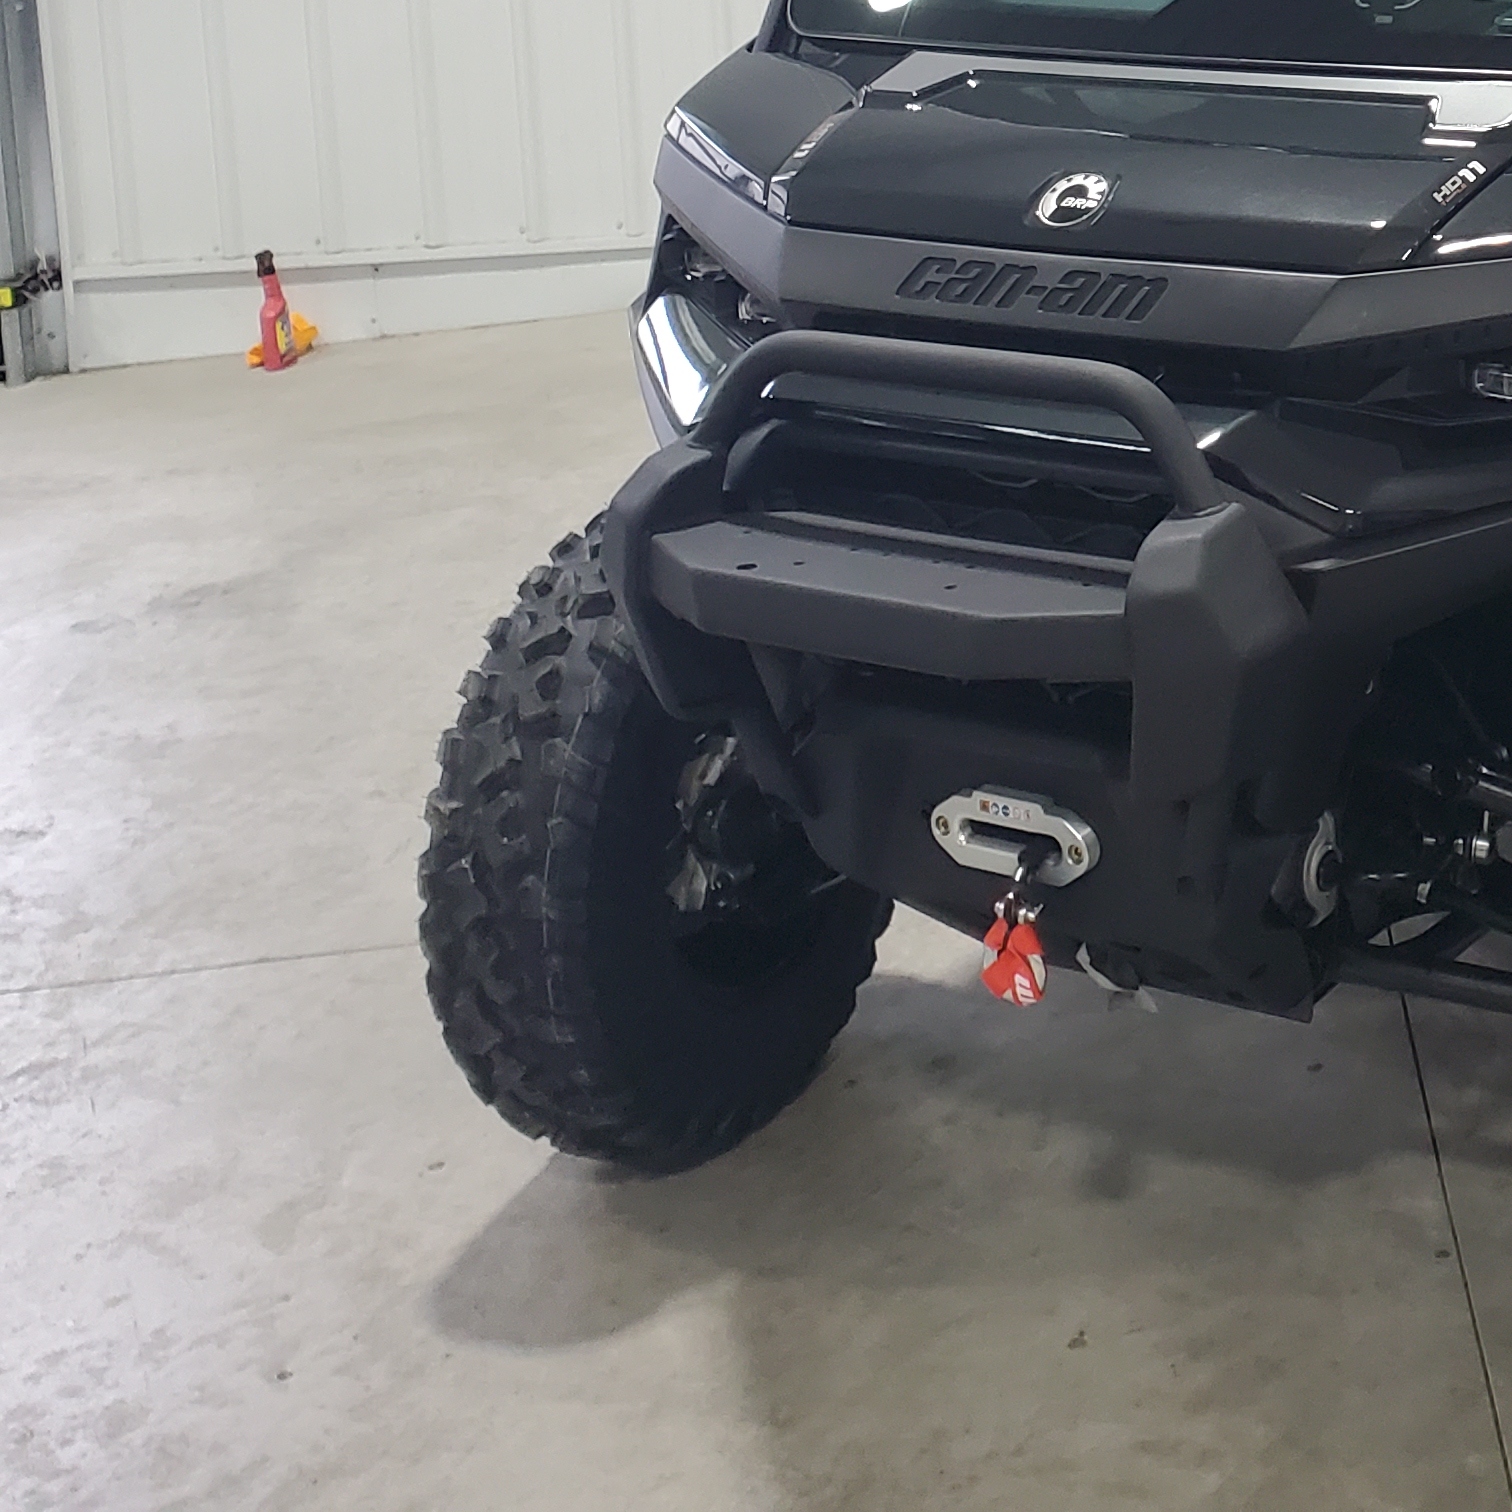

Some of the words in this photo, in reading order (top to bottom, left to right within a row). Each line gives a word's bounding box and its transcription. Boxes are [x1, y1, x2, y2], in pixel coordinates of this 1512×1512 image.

[1060, 196, 1098, 210] BRP
[1432, 160, 1487, 203] HD11
[896, 256, 1170, 322] can-am
